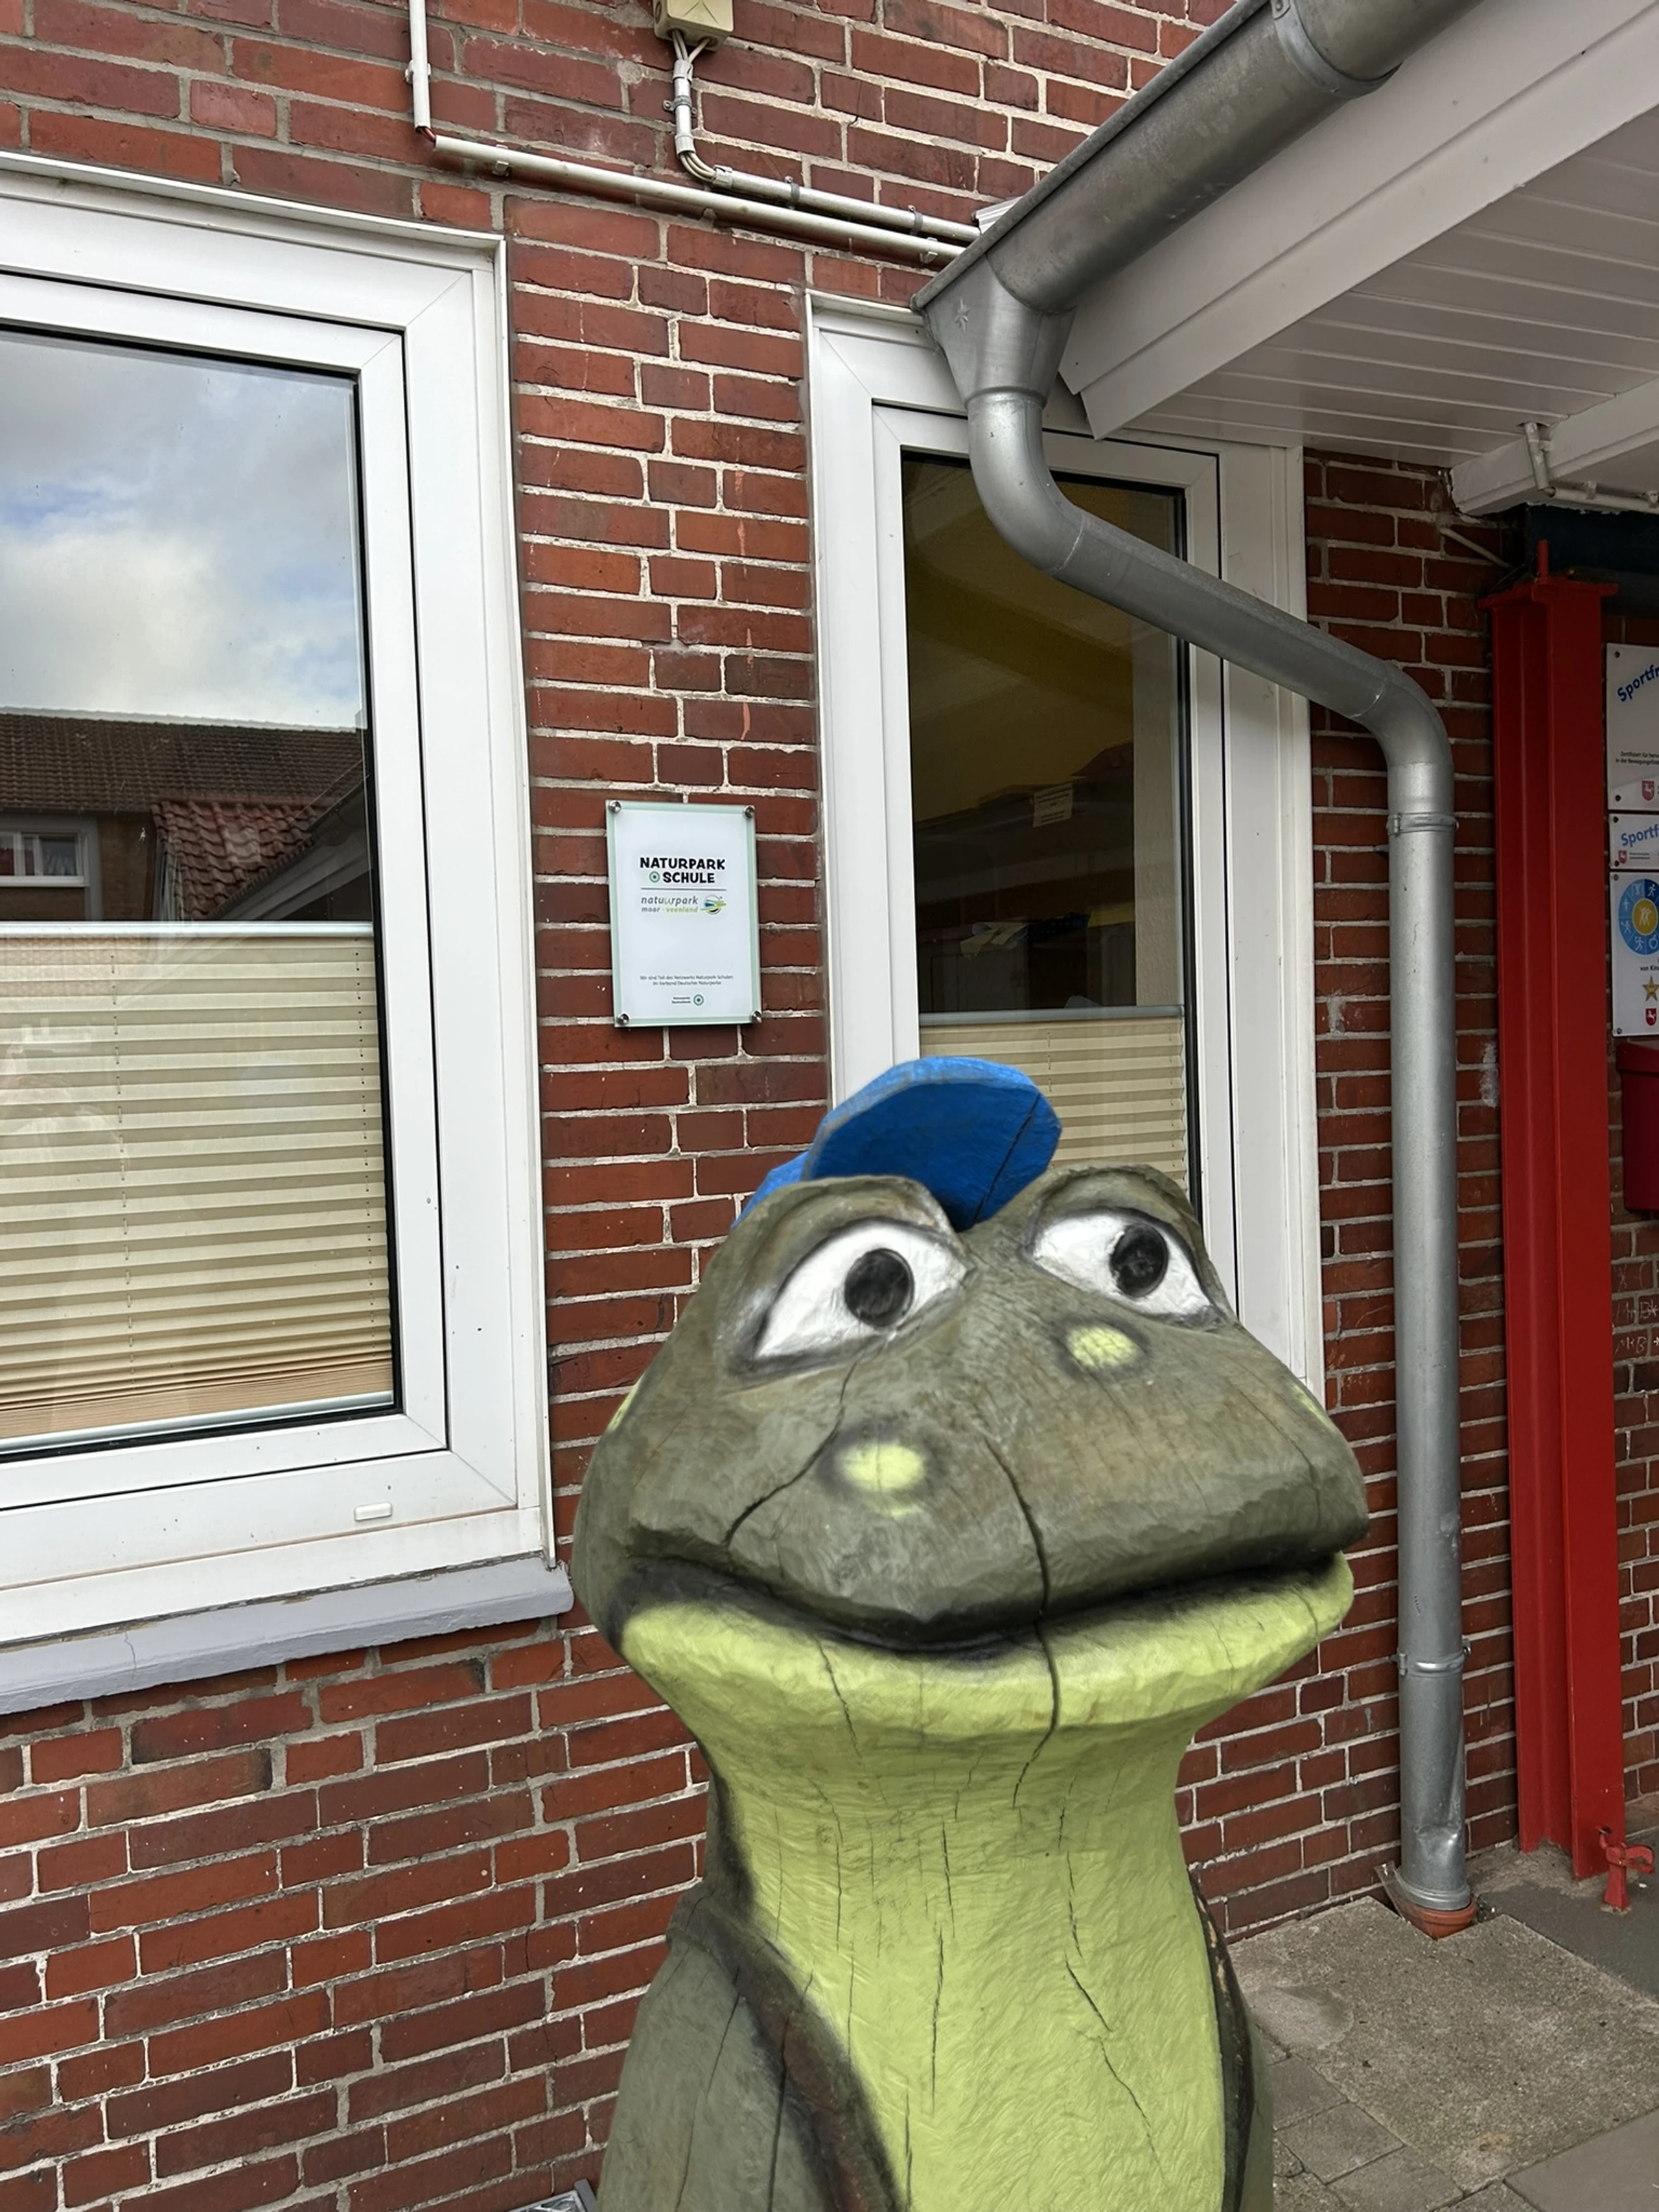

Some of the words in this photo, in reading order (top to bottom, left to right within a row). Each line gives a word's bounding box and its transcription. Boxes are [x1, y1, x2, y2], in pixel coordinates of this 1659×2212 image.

[640, 857, 726, 870] NATURPARK
[662, 871, 715, 883] SCHULE
[641, 896, 699, 907] natuurpark
